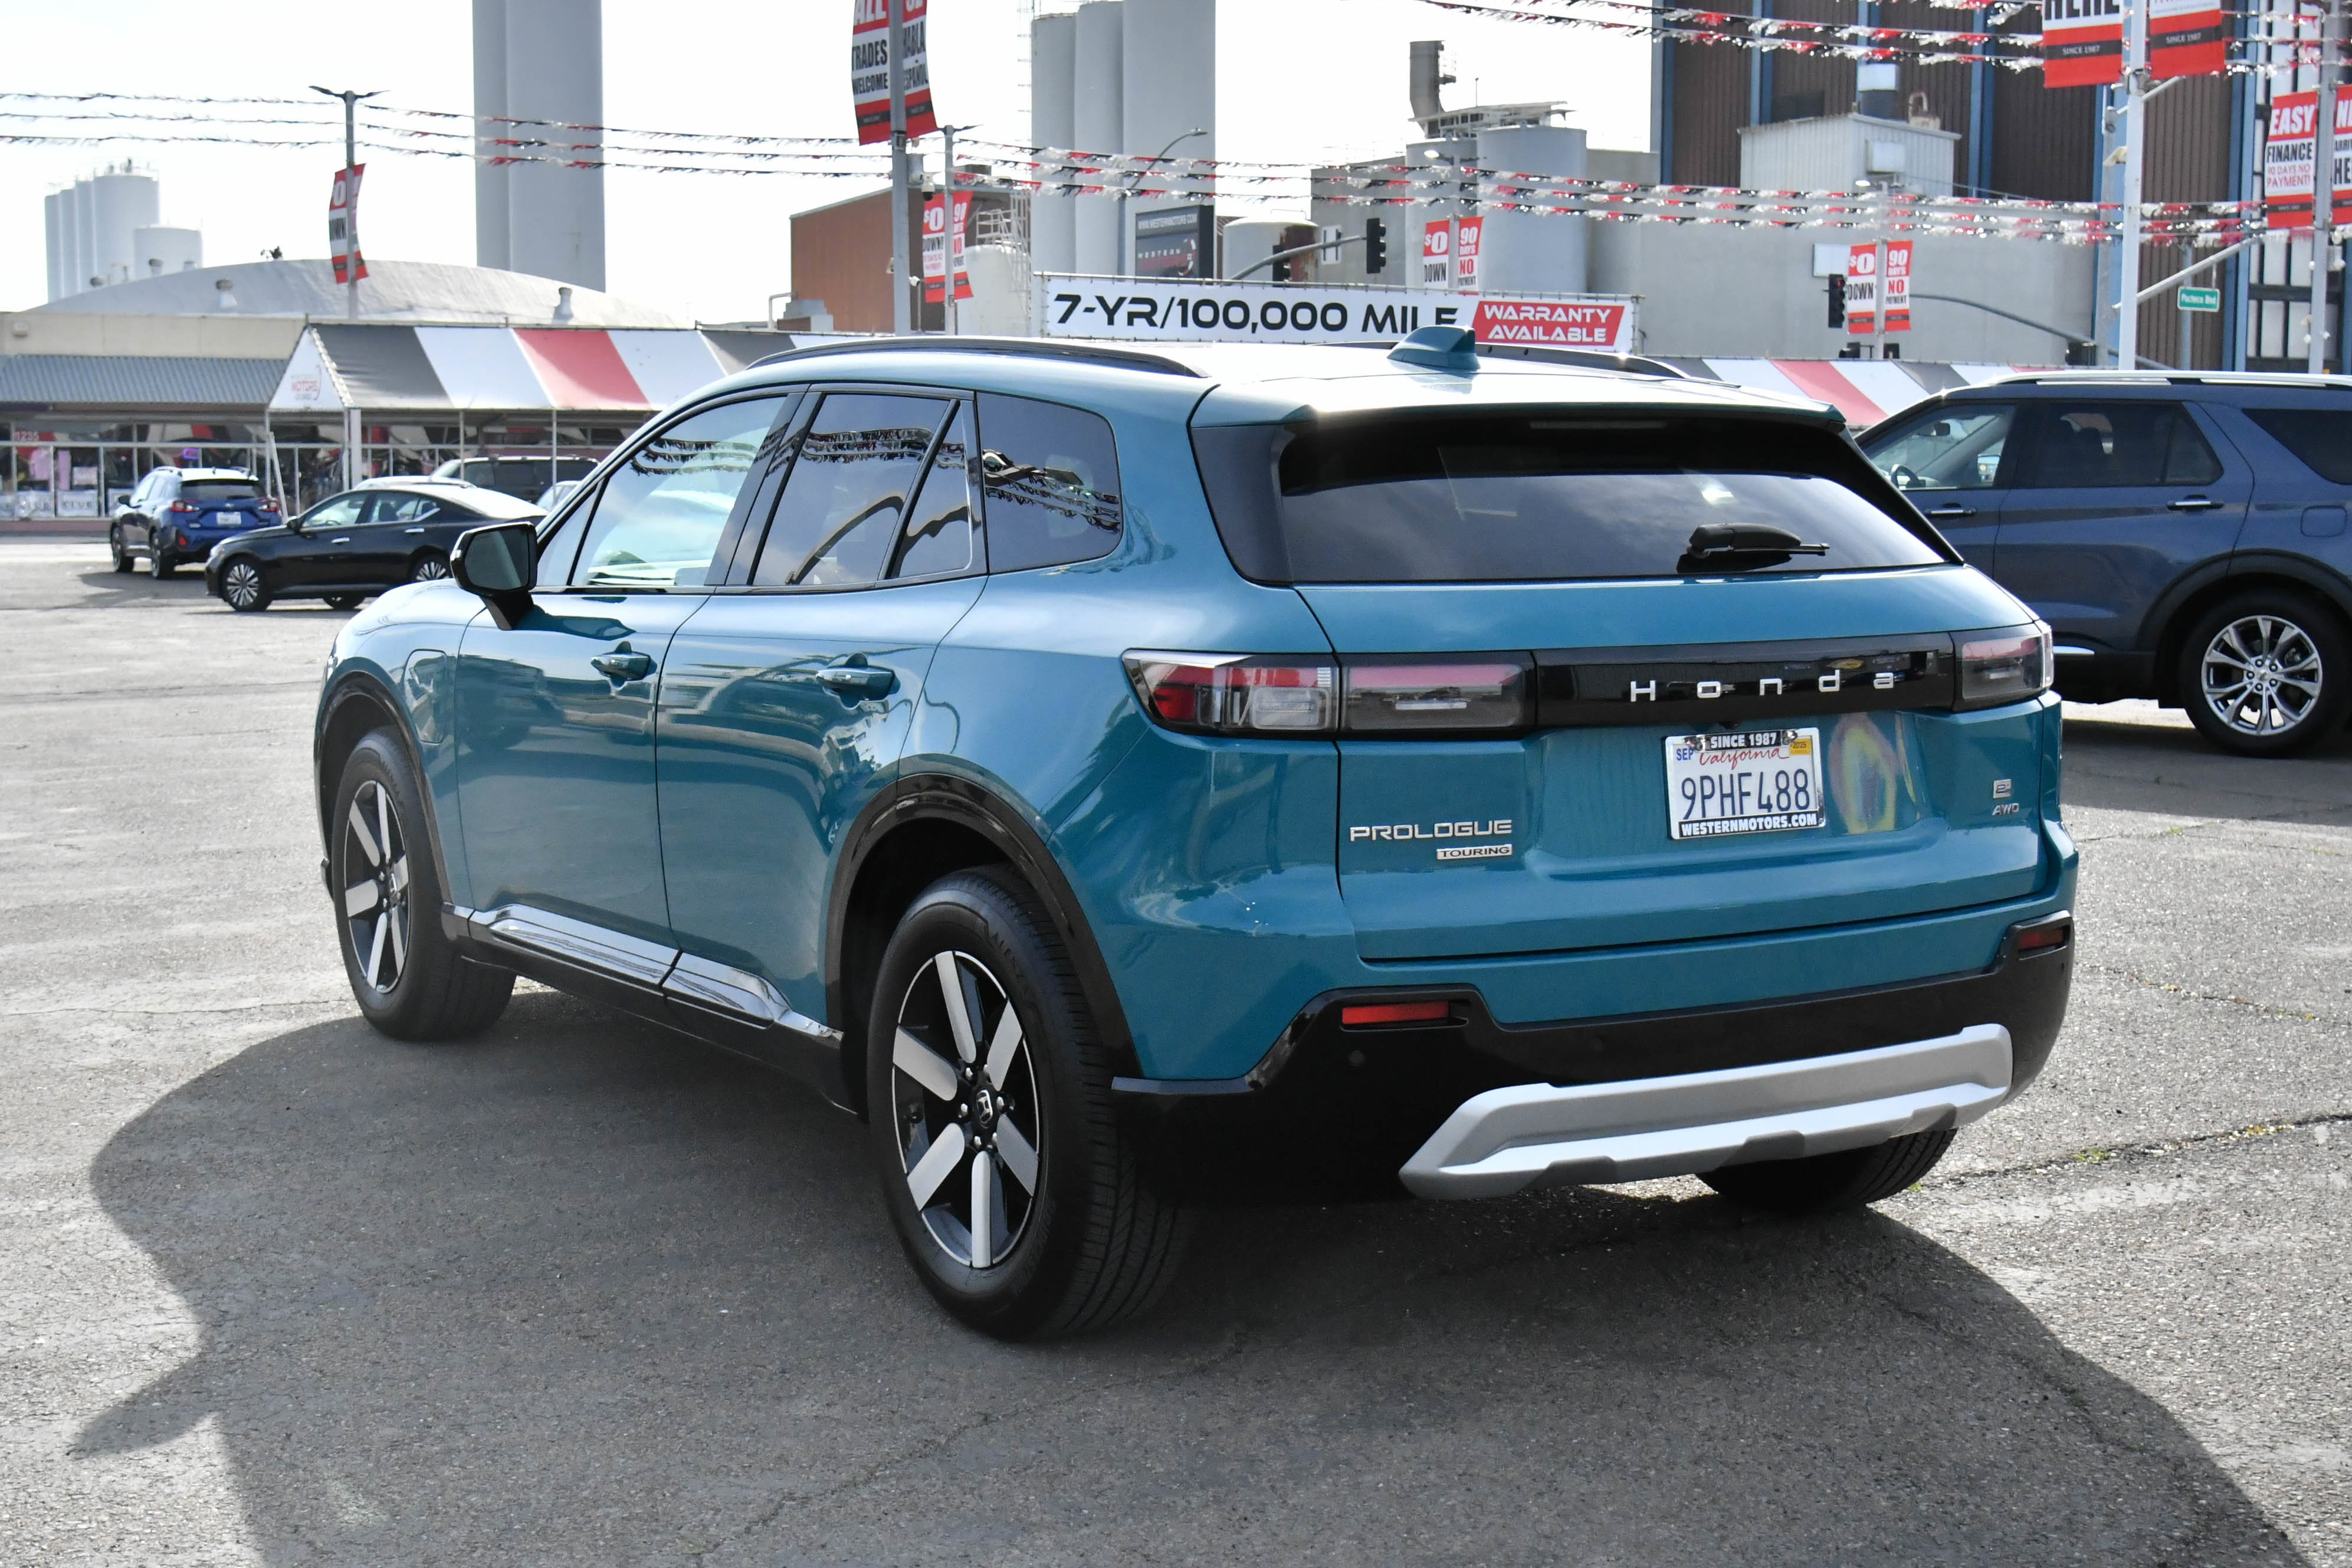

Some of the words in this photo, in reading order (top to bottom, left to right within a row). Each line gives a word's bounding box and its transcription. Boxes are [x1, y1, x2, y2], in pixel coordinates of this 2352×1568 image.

[2062, 47, 2082, 55] SINCE
[2269, 104, 2315, 136] EASY
[2266, 142, 2312, 163] FINANCE
[2277, 164, 2297, 173] DAYS
[2299, 163, 2311, 172] NO
[1424, 231, 1448, 254] $0
[1461, 227, 1478, 245] 90
[1460, 258, 1474, 275] NO
[1849, 252, 1875, 274] $0
[1888, 249, 1908, 266] 90
[1424, 263, 1446, 283] DOWN
[1888, 280, 1904, 294] NO
[1054, 293, 1347, 334] 7-YR/100,000
[1484, 305, 1611, 323] WARRANTY
[1488, 326, 1607, 343] AVAILABLE
[1711, 736, 1746, 749] SINCE
[1749, 733, 1777, 746] 1987
[1676, 748, 1694, 761] SEP
[1700, 747, 1790, 770] California
[1681, 768, 1810, 820] 9PHF488
[1992, 803, 2019, 816] AWD
[1350, 819, 1512, 842] PROLOGUE
[1681, 813, 1818, 837] WESTERNMOTORS.COM
[1440, 847, 1510, 858] TOURING
